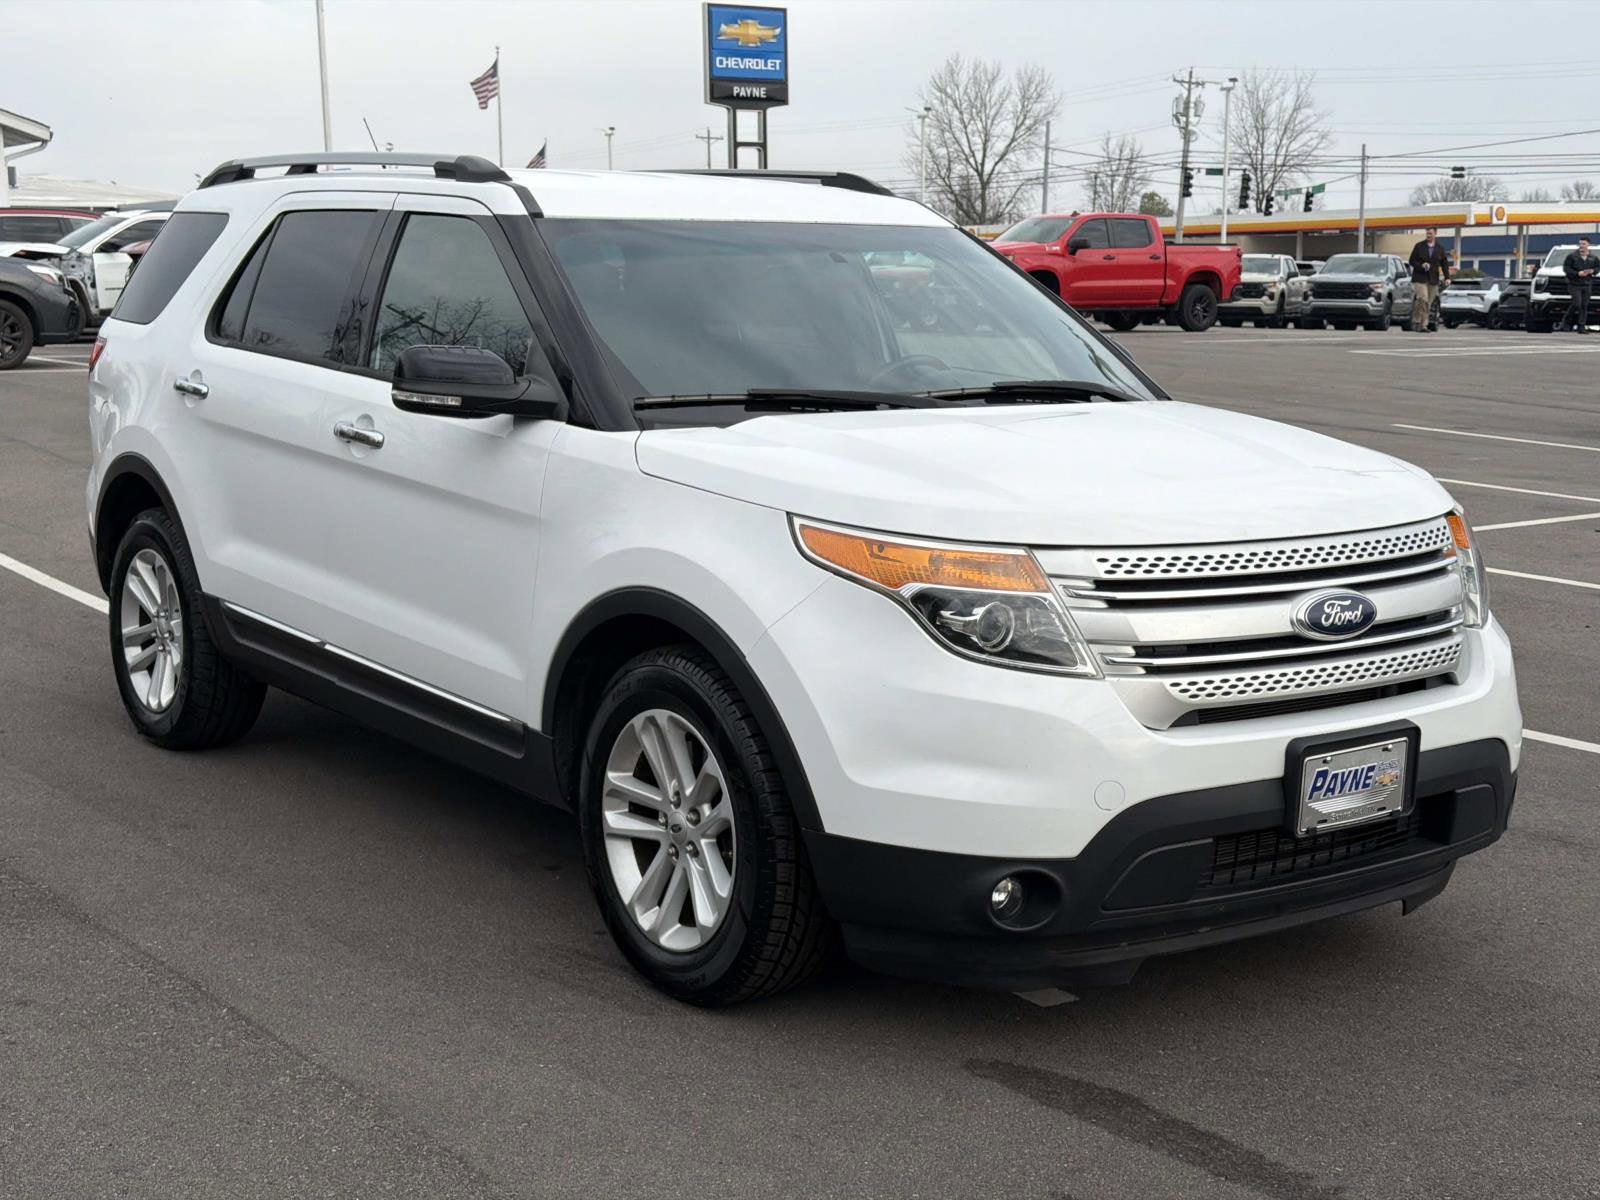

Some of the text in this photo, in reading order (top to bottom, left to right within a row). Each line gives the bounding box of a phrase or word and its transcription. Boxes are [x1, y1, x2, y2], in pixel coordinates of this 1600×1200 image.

[716, 56, 781, 70] CHEVROLET
[733, 86, 767, 98] PAYNE
[1321, 599, 1363, 627] Ford
[1307, 764, 1376, 801] PAYNE
